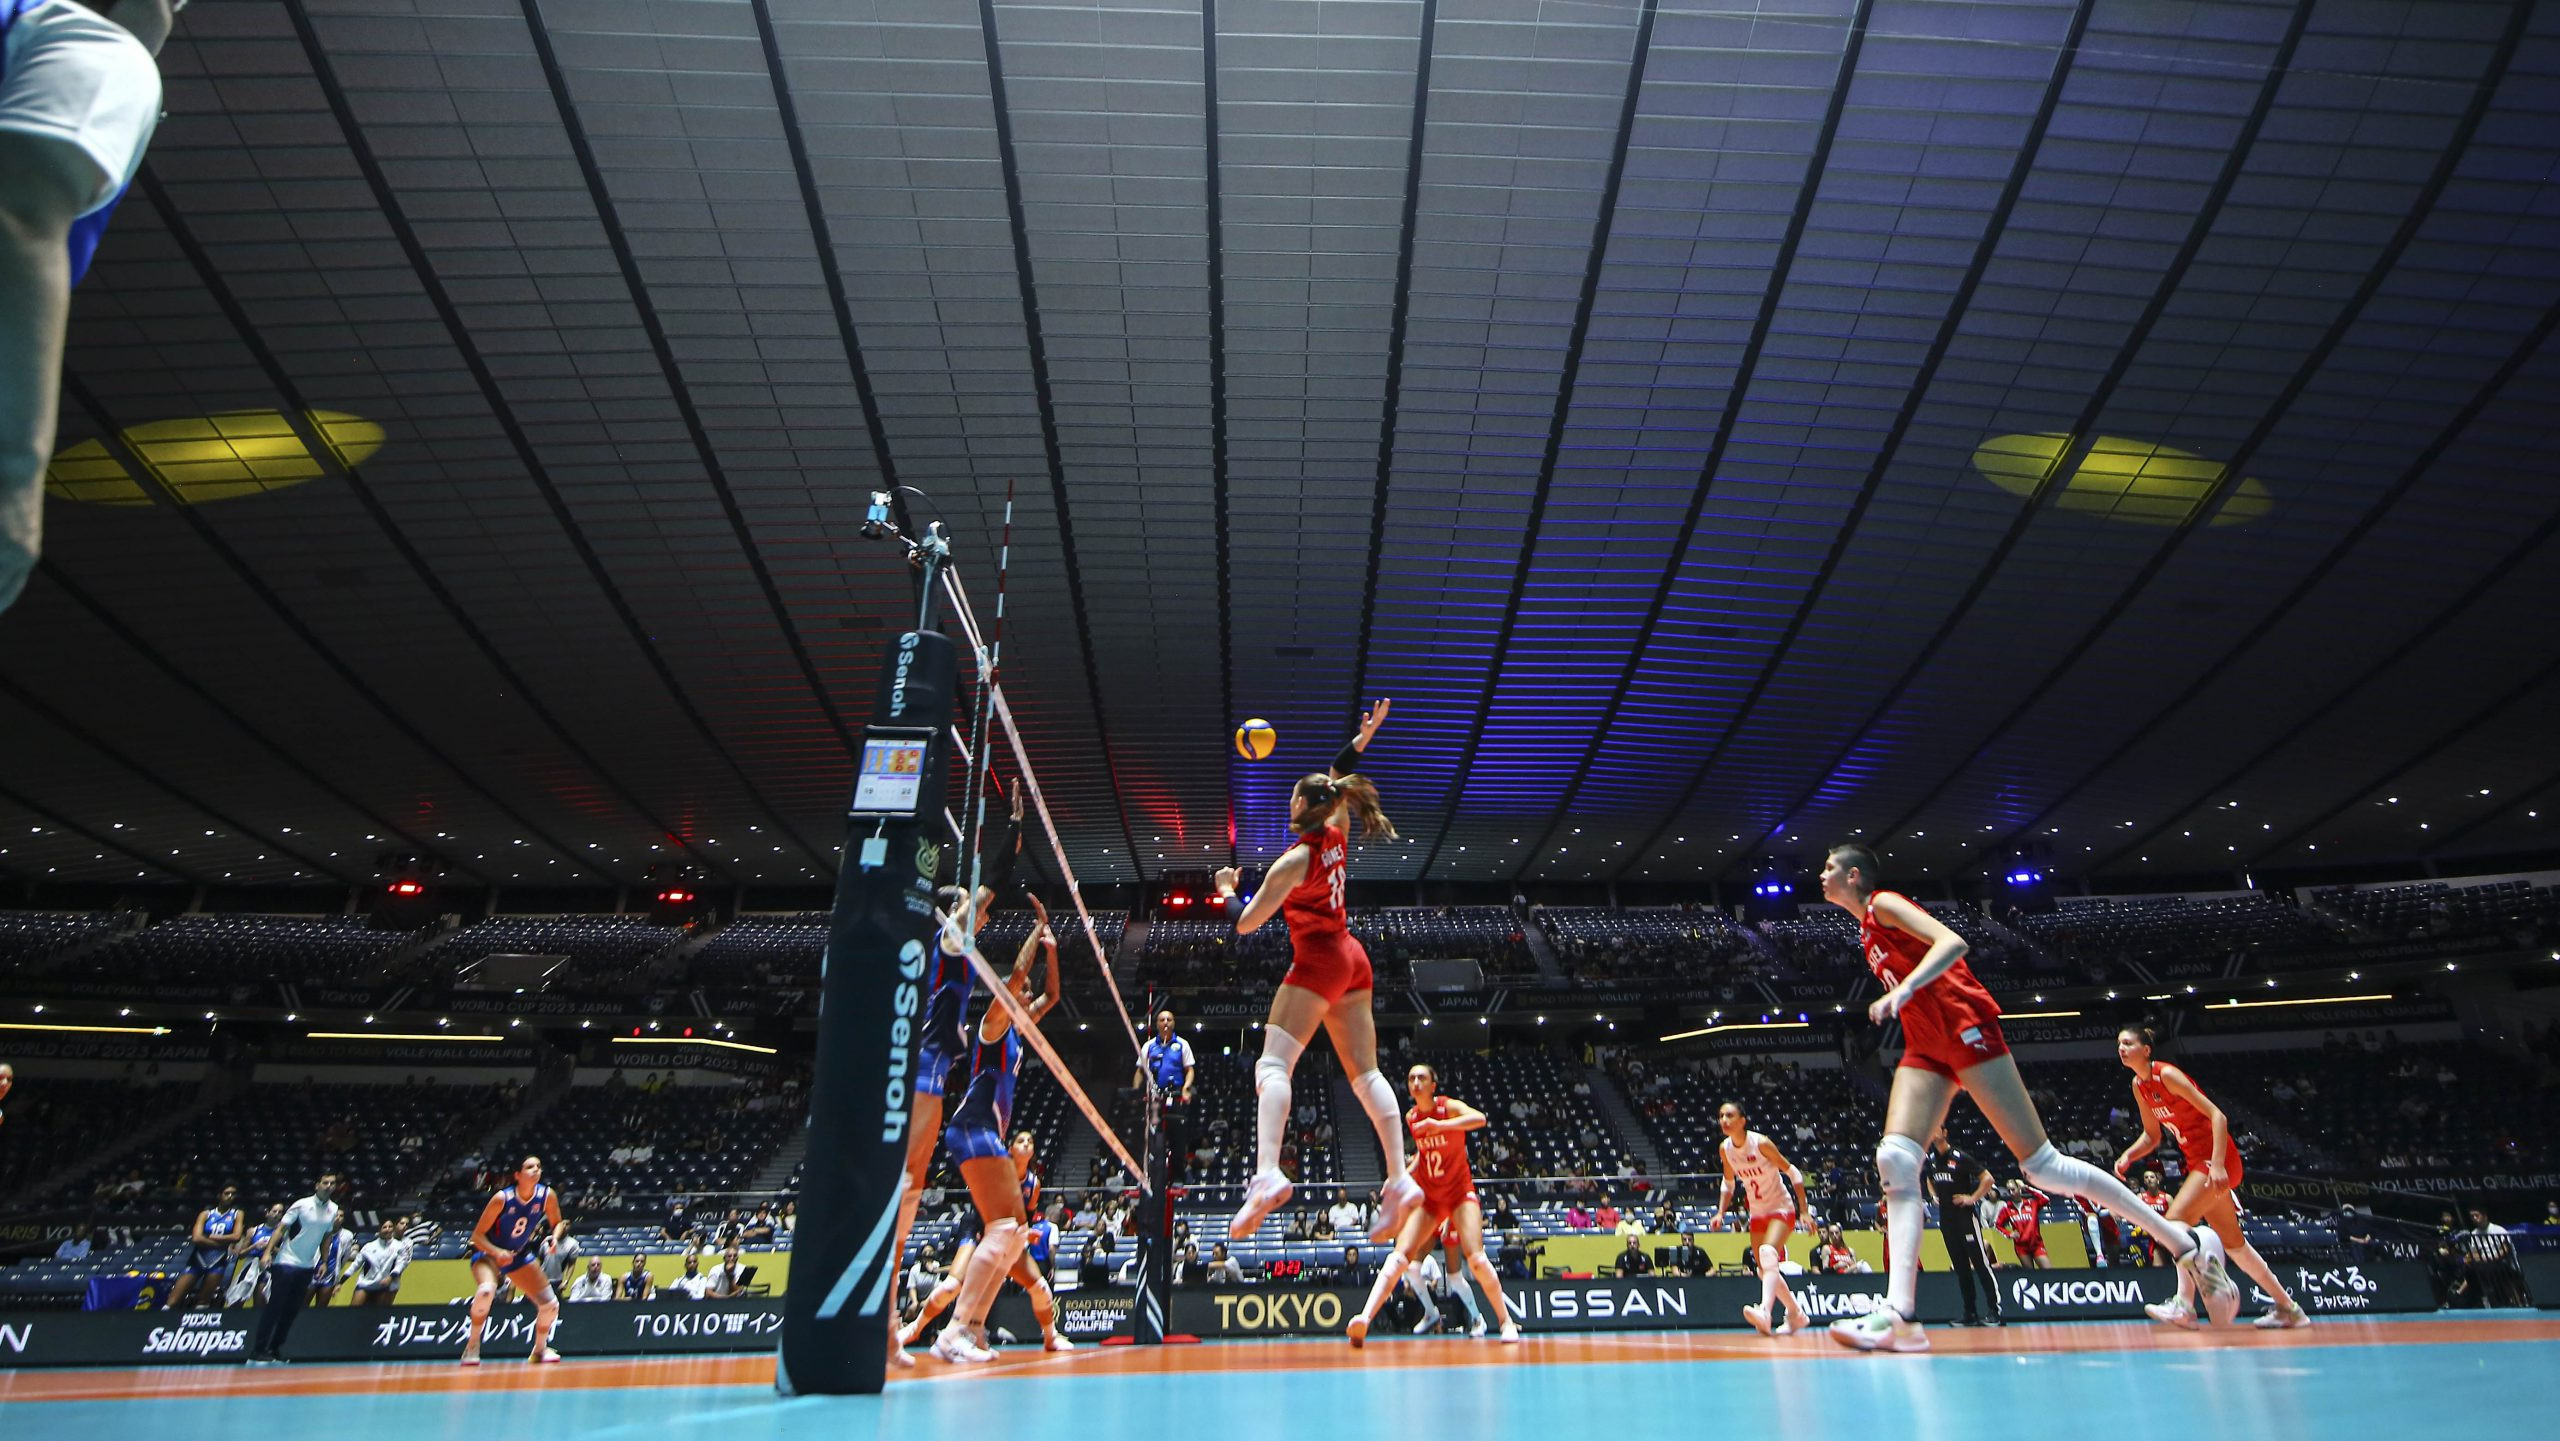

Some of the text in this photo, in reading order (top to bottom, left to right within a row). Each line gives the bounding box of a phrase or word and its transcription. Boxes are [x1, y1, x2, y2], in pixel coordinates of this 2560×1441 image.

[890, 651, 914, 717] Senoh
[2166, 963, 2211, 976] JAPAN
[1791, 984, 1834, 997] TOKYO
[2024, 977, 2066, 988] JAPAN
[319, 989, 372, 1003] TOKYO
[1437, 996, 1478, 1008] JAPAN
[452, 1000, 623, 1014] WORLD CUP 2023 JAPAN
[1203, 1004, 1248, 1015] WORLD
[1710, 1035, 1776, 1049] VOLLEYBALL
[1779, 1033, 1834, 1046] QUALIFIER
[2032, 1029, 2072, 1041] 2023
[62, 1043, 98, 1056] CUP
[153, 1047, 210, 1059] JAPAN
[386, 1048, 466, 1058] VOLLEYBALL
[469, 1048, 533, 1059] QUALIFIER
[613, 1053, 668, 1066] WORLD
[672, 1054, 702, 1067] CUP
[704, 1056, 738, 1071] 2023
[882, 982, 918, 1143] Senoh
[1425, 1150, 1445, 1178] 12
[1750, 1180, 1762, 1200] 2
[2251, 1183, 2297, 1198] ROAD
[2300, 1183, 2321, 1198] TO
[2371, 1176, 2481, 1195] VOLLEYBALL
[511, 1216, 528, 1239] 8
[2296, 1265, 2378, 1293] たべる。
[2043, 1280, 2144, 1305] KICONA
[1065, 1299, 1134, 1310] ROAD TO PARIS
[2314, 1295, 2370, 1309] ジャパネット
[1065, 1309, 1127, 1321] VOLLEYBALL
[1214, 1292, 1342, 1330] TOKYO
[633, 1313, 721, 1337] TOKIO
[1064, 1320, 1114, 1333] QUALIFIER
[142, 1326, 247, 1358] Salonpas
